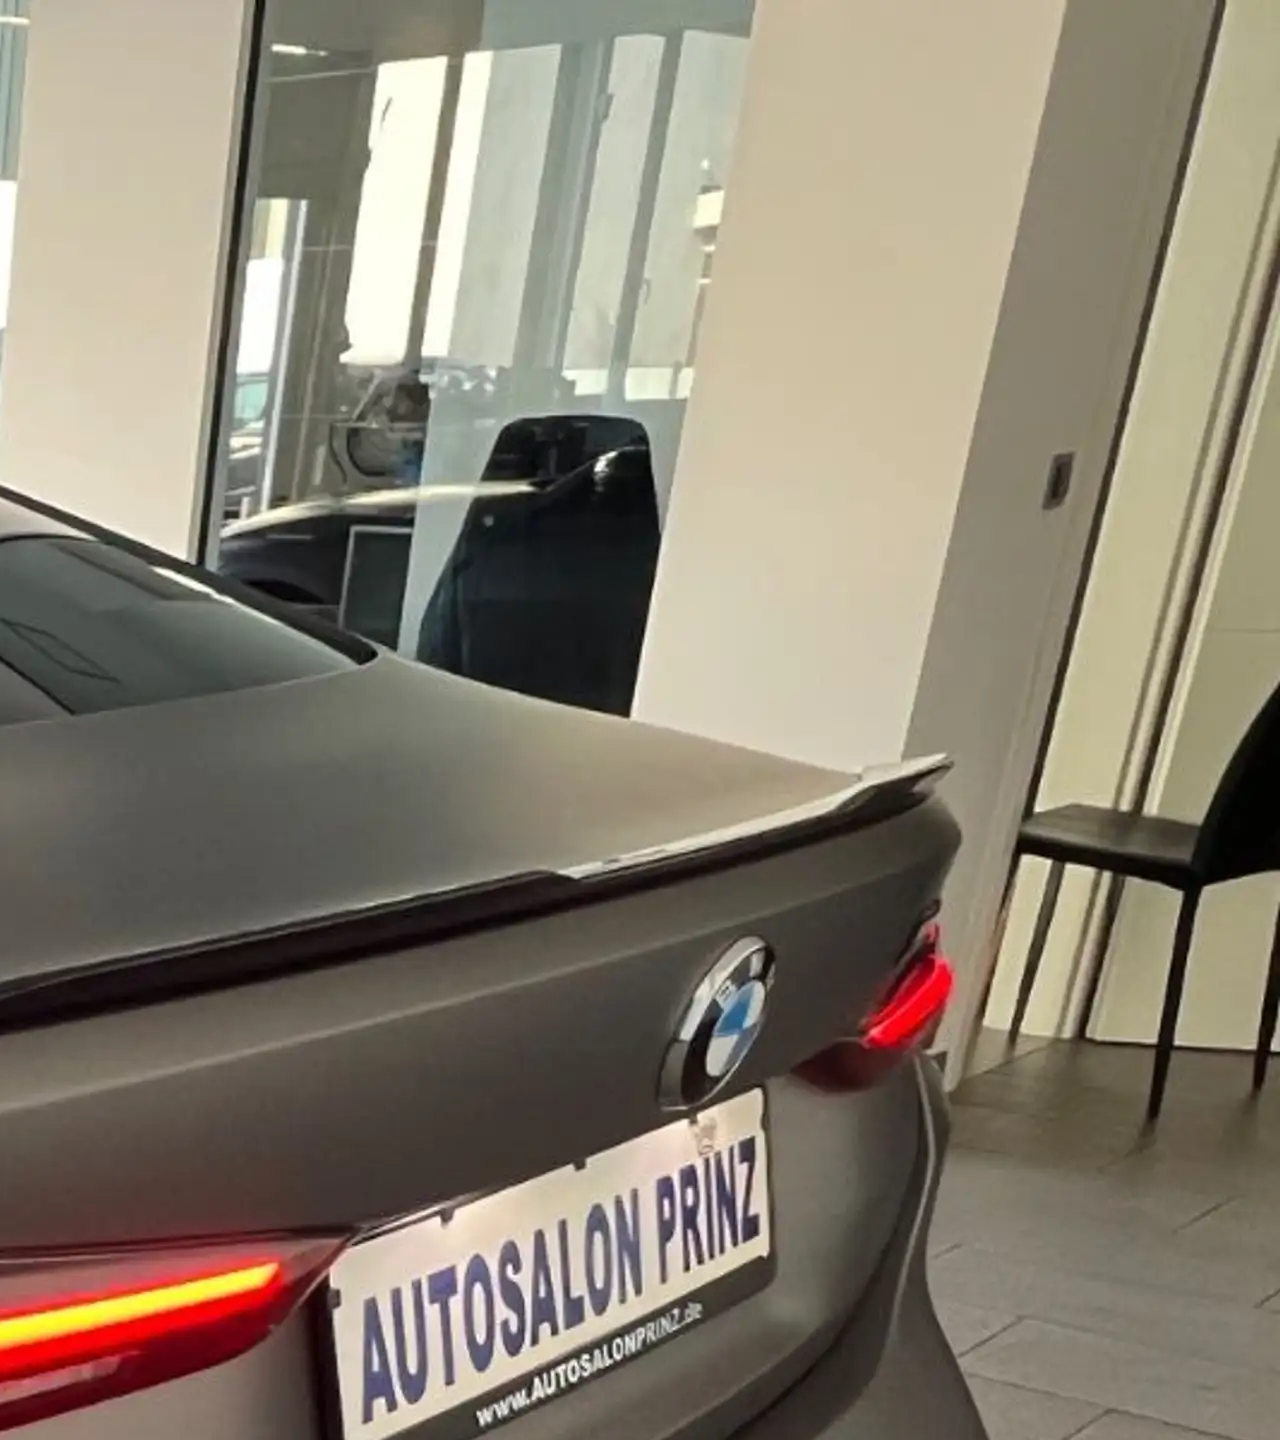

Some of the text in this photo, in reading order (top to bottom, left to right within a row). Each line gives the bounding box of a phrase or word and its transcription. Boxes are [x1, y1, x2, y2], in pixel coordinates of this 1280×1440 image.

[361, 1136, 761, 1424] AUTOSALON PRINZ
[476, 1301, 704, 1428] www.AUTOSALONPRINZ.de
